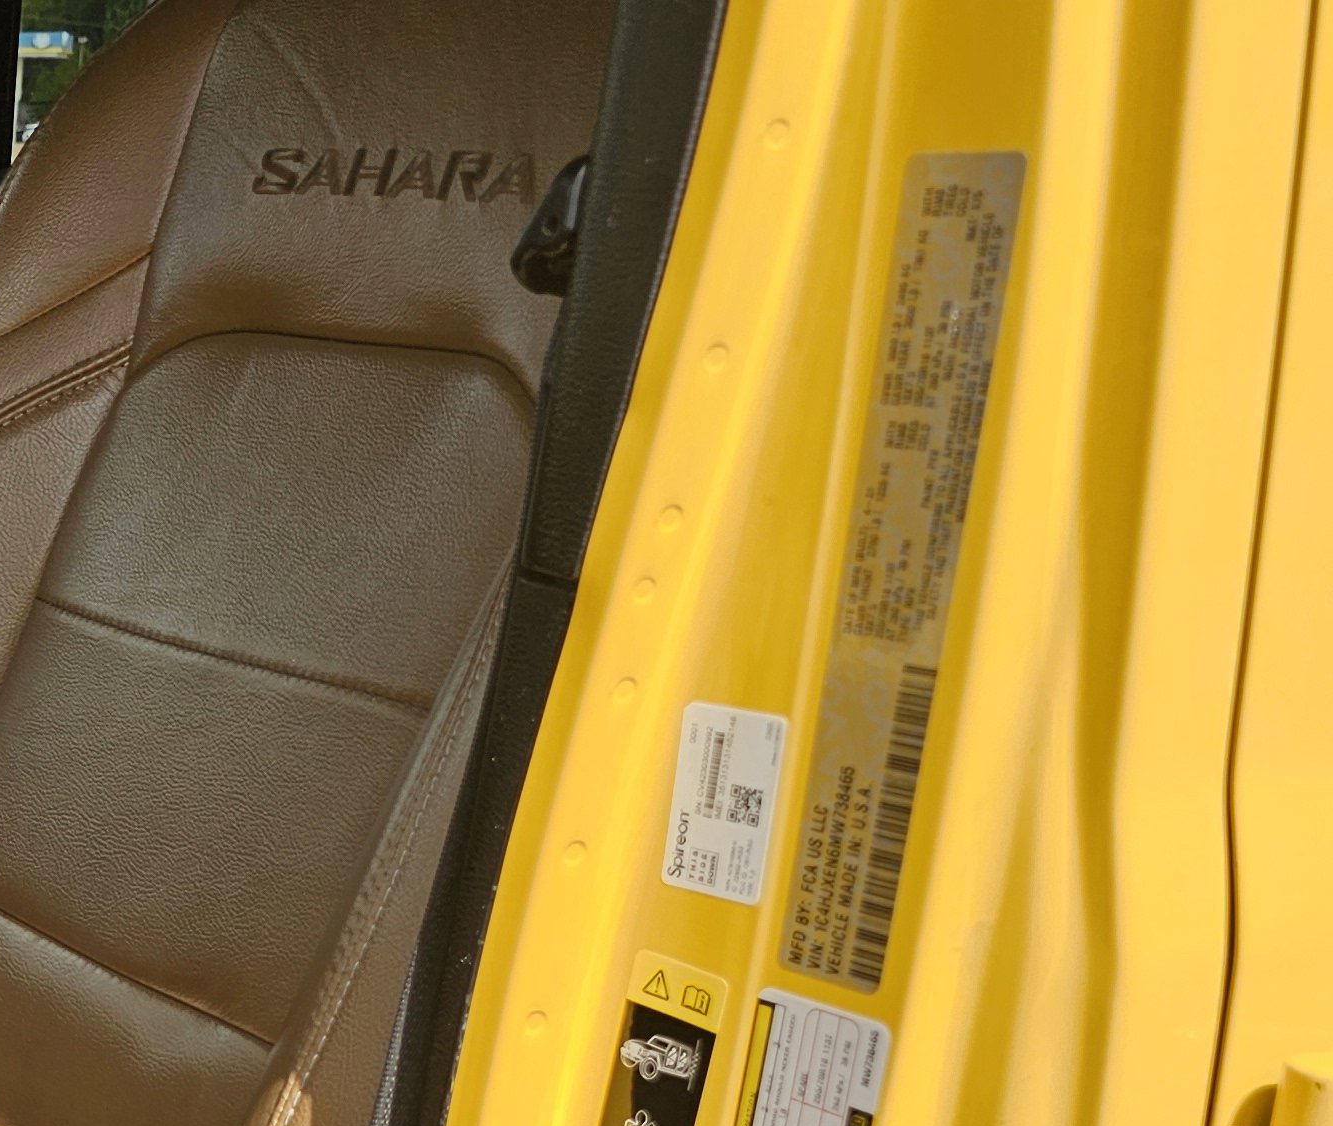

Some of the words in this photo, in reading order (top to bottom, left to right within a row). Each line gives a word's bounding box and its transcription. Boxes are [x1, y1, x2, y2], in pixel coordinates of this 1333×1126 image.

[251, 146, 536, 206] SAHARA
[808, 802, 829, 834] LLC
[666, 810, 691, 878] Spireon
[804, 835, 823, 860] US
[811, 763, 856, 934] 1C4HJXEN6MW738465
[688, 849, 698, 879] THIS
[697, 853, 707, 882] SIDE
[706, 855, 716, 884] DOWN
[798, 862, 818, 894] FCA
[835, 861, 858, 909] MADE
[793, 898, 812, 927] BY:
[786, 928, 807, 966] MFD
[805, 938, 825, 972] VIN:
[824, 911, 850, 978] VEHICLE
